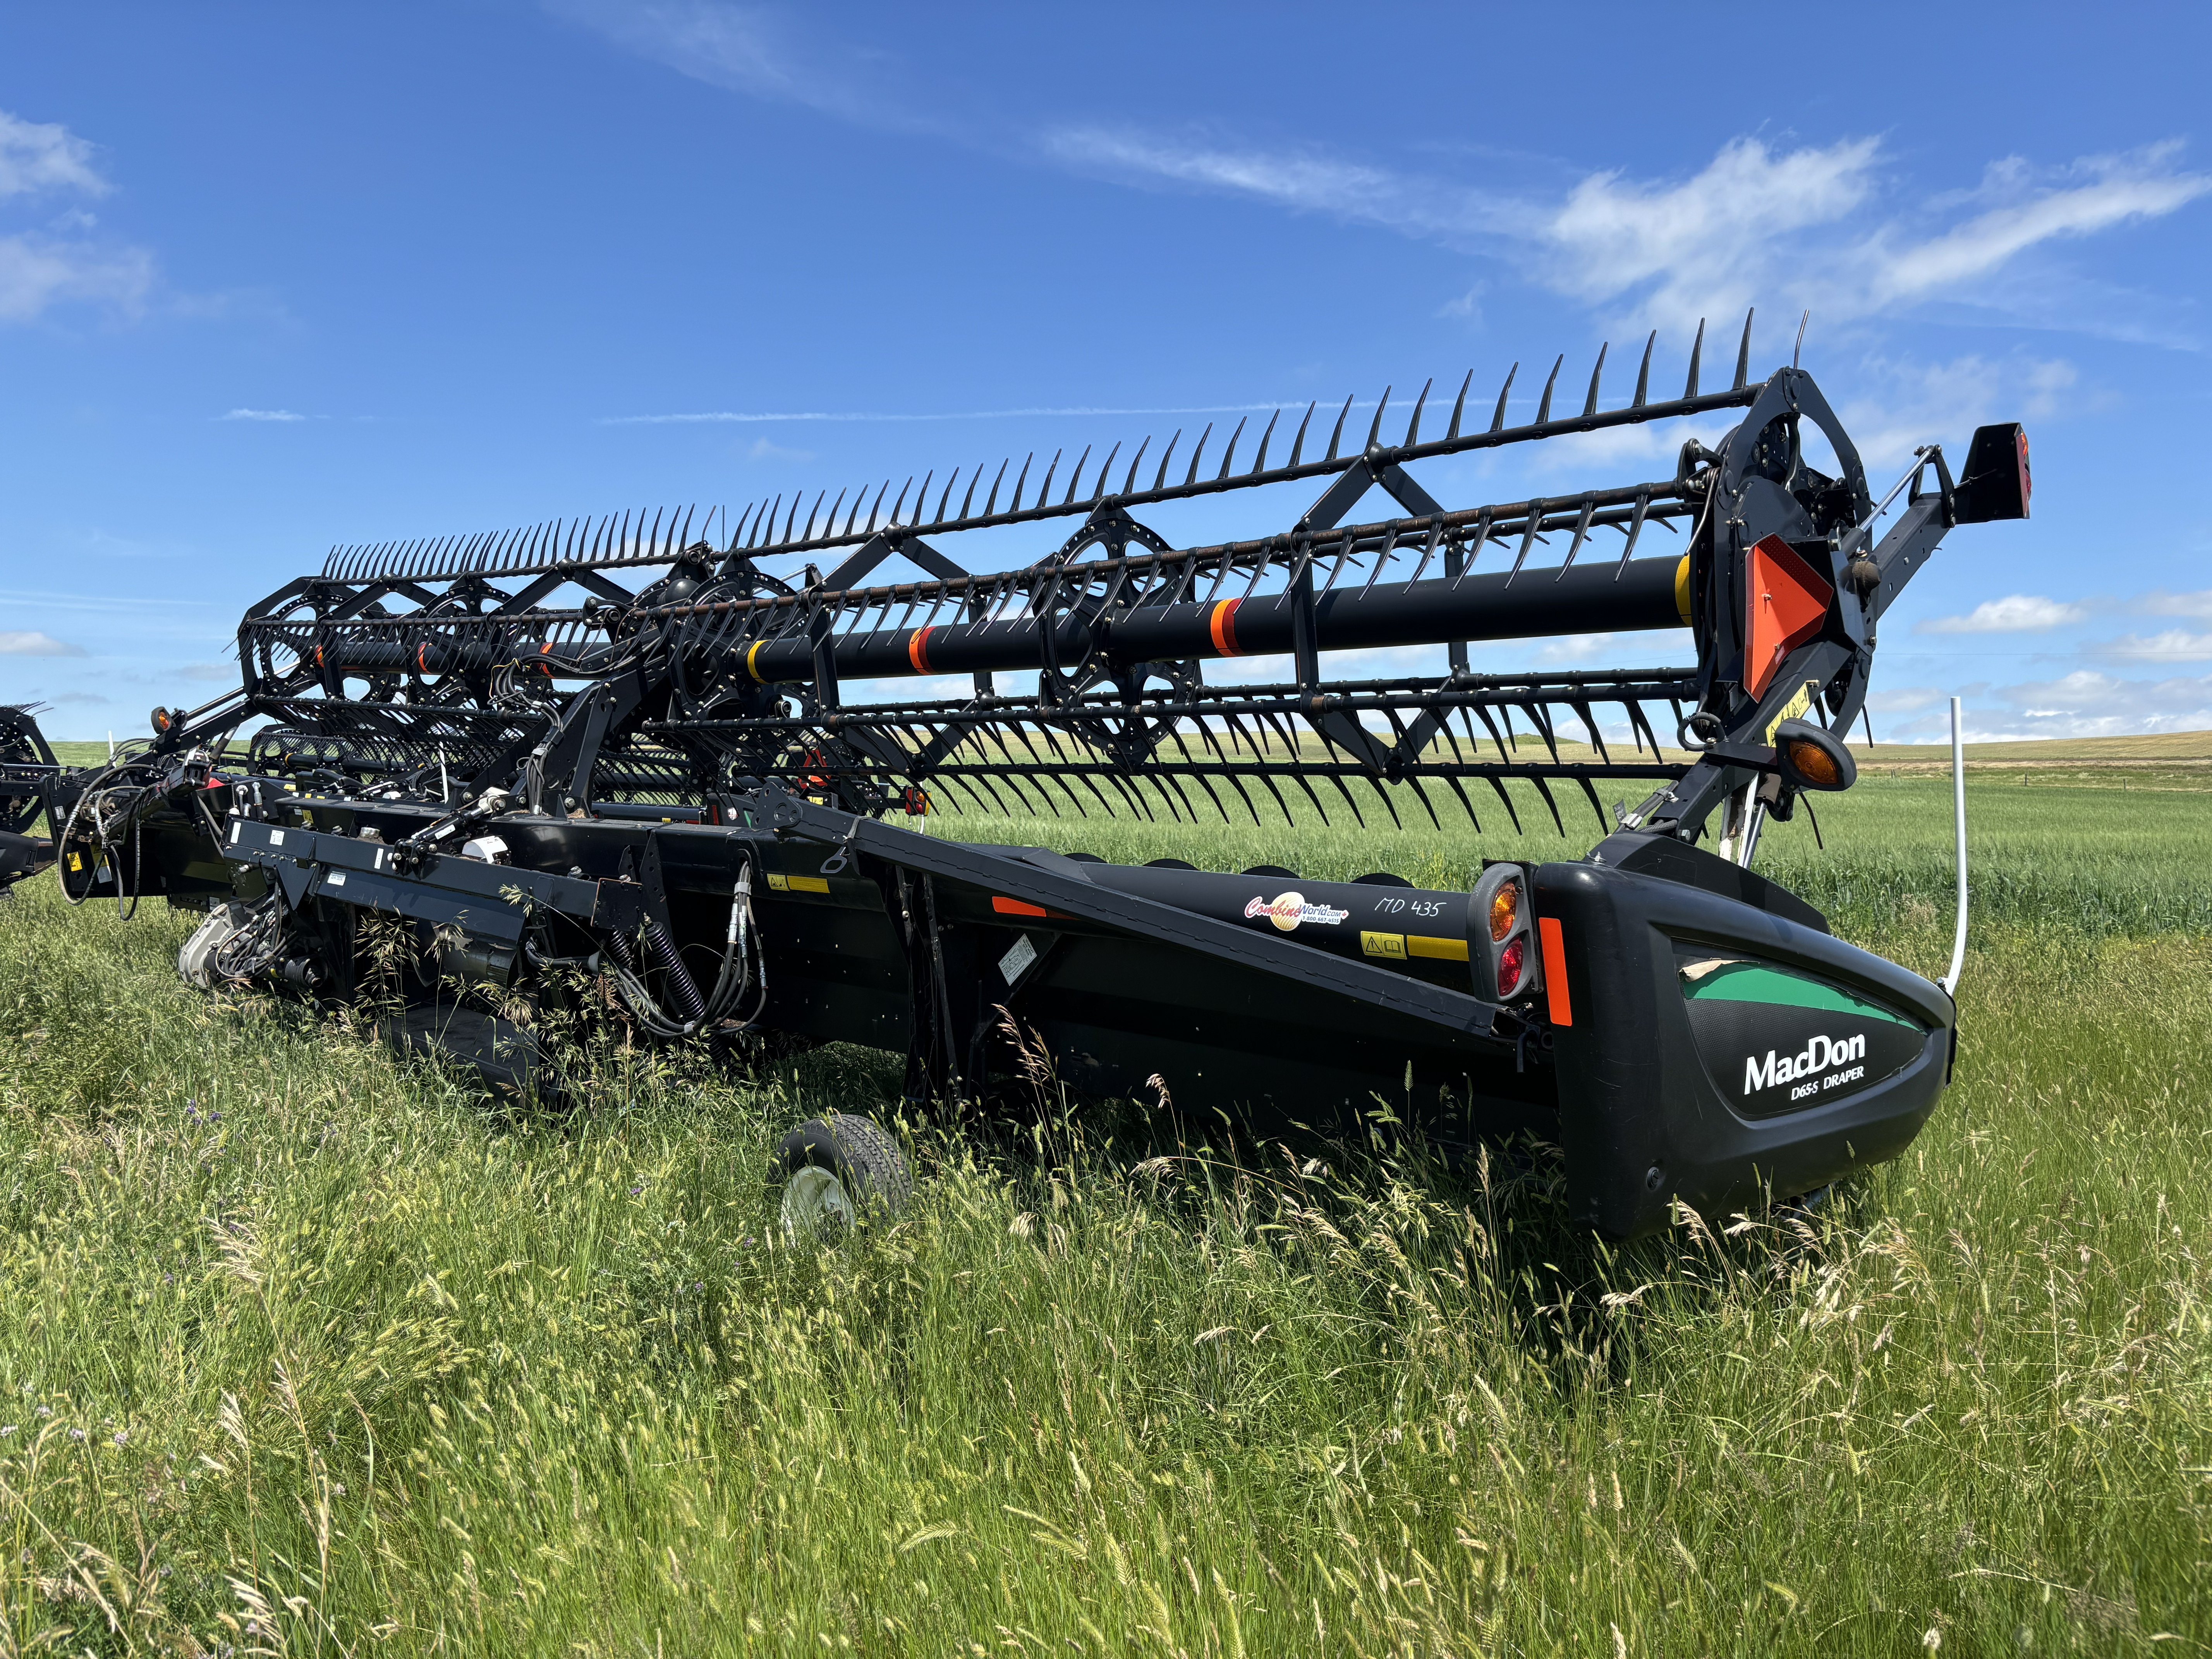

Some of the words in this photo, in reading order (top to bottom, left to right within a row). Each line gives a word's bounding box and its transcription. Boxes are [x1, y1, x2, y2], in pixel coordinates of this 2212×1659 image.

[1375, 897, 1405, 913] MD
[1411, 901, 1447, 917] 435
[1744, 1034, 1865, 1095] MacDon
[1823, 1066, 1864, 1090] DRAPER
